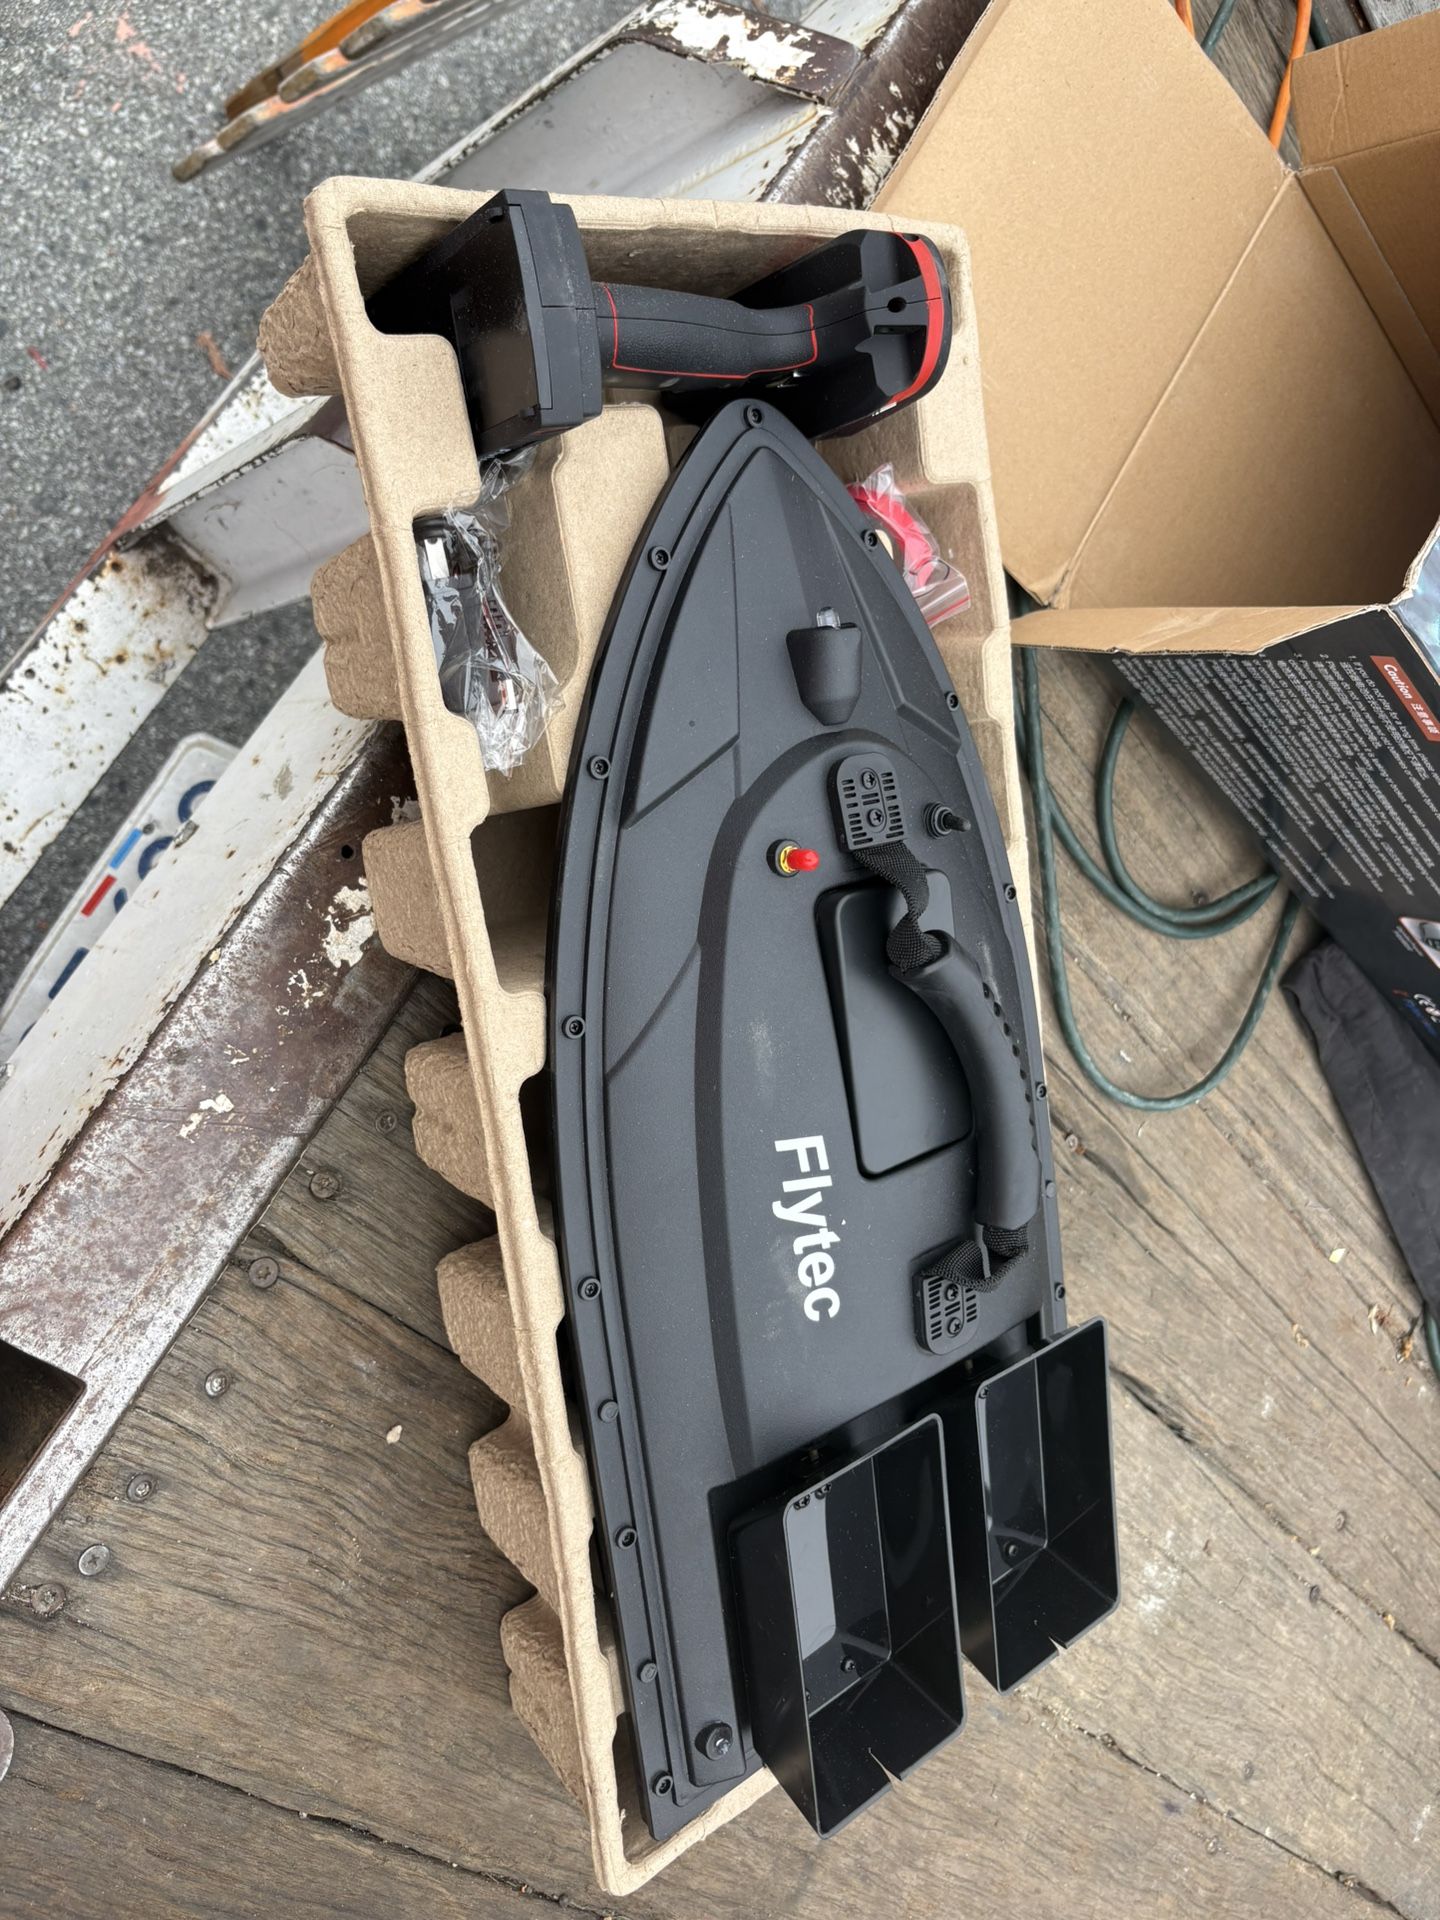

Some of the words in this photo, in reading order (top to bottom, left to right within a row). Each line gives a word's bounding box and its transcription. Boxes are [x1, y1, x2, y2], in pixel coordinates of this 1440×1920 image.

[1355, 667, 1369, 677] you
[1326, 661, 1343, 680] Please
[1347, 691, 1359, 699] not
[1383, 664, 1412, 699] Caution
[1372, 688, 1385, 697] not
[1377, 698, 1392, 710] play
[1398, 725, 1411, 738] long
[772, 1135, 841, 1322] Flytec
